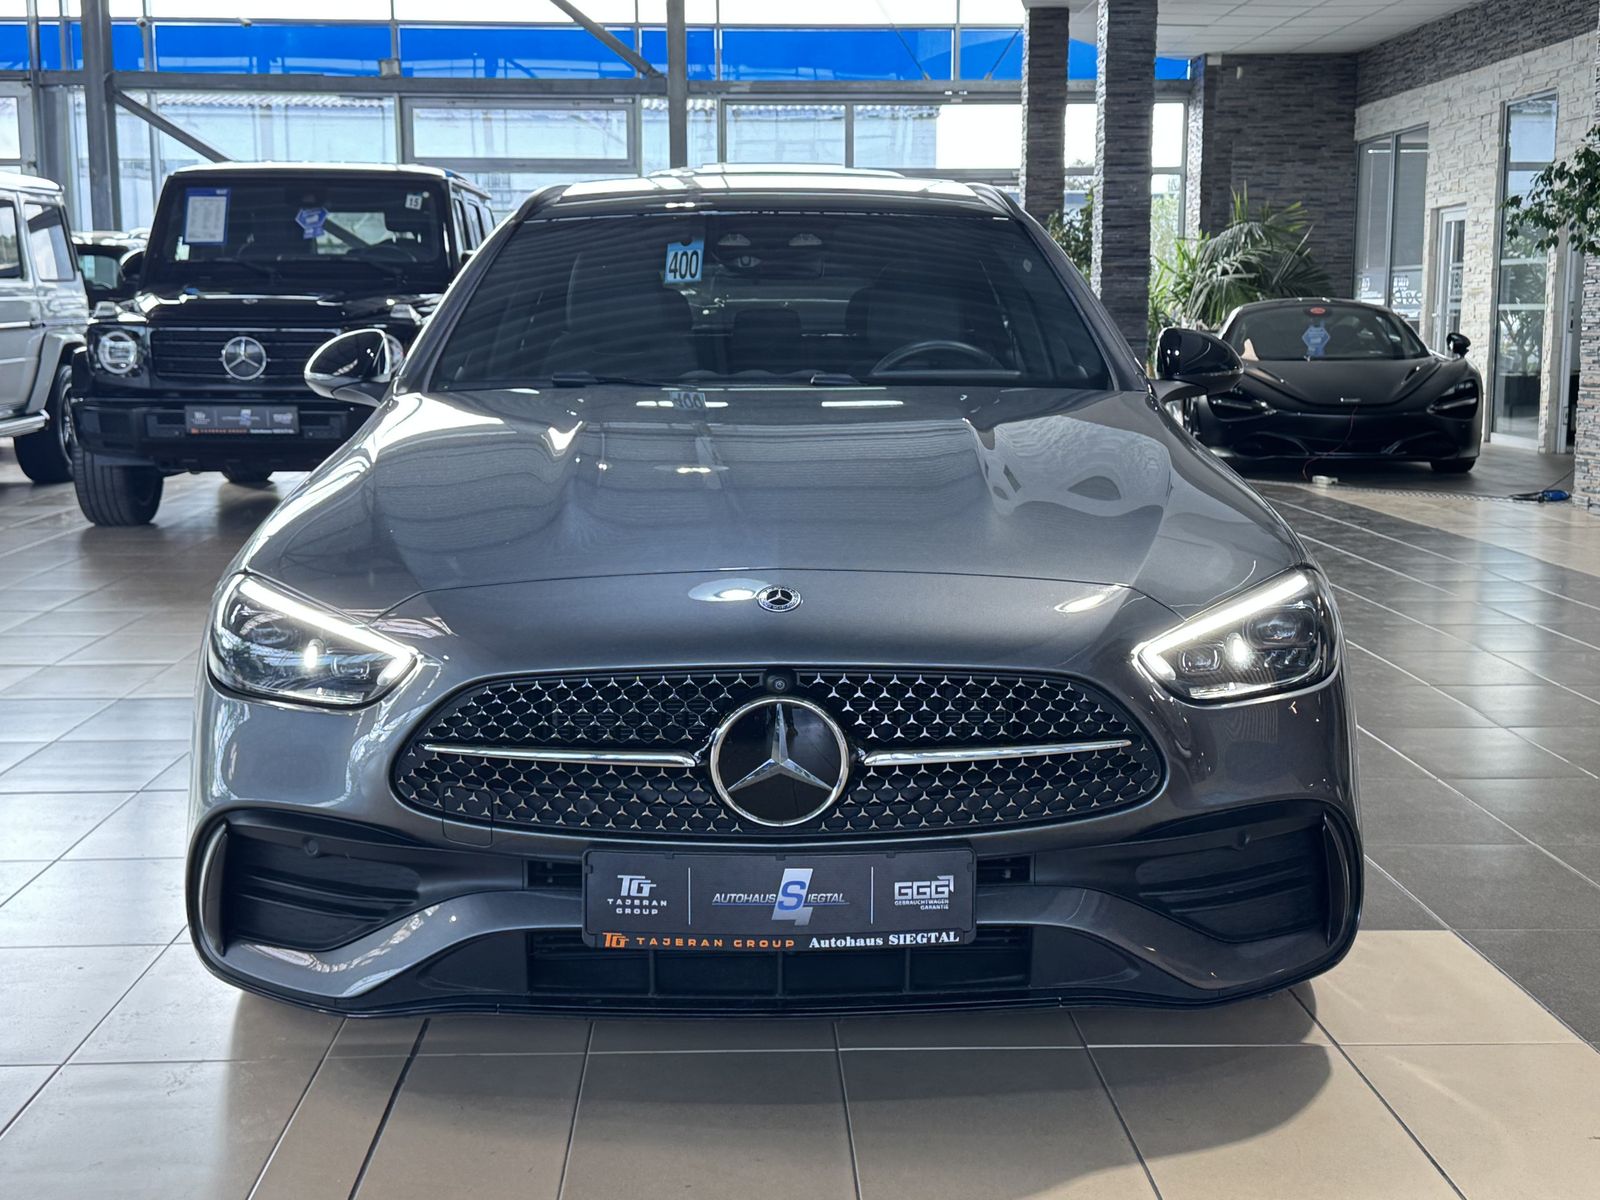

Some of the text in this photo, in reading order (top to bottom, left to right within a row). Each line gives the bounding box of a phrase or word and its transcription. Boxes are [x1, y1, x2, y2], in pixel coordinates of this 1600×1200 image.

[669, 250, 699, 279] 400
[617, 875, 657, 897] TG
[894, 880, 949, 900] GGG
[607, 899, 668, 907] TAJERAN
[712, 893, 776, 903] AUTOHAUS
[636, 937, 724, 947] TAJERAN
[733, 939, 795, 947] GROUP
[809, 931, 960, 948] Autohaus SIEGTAL
